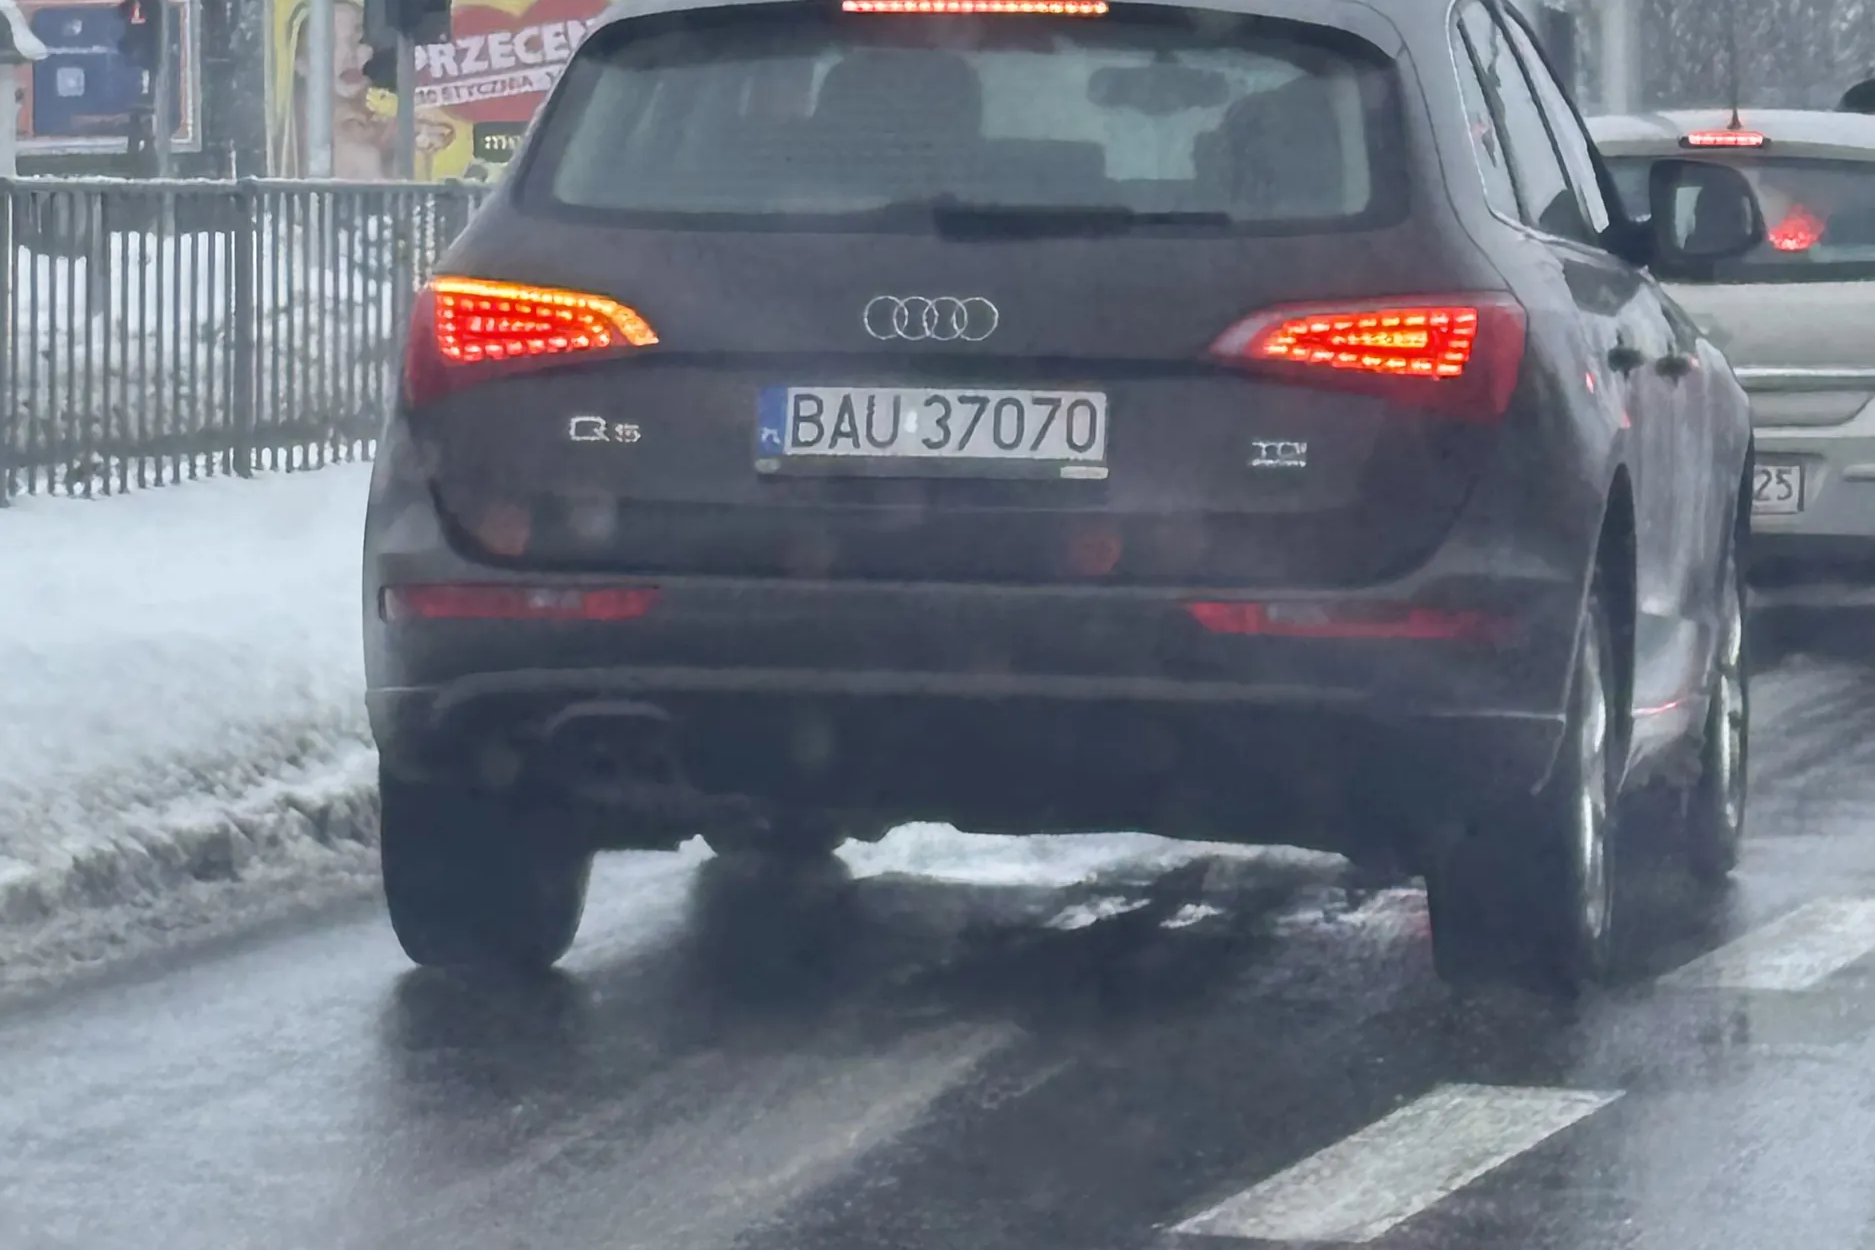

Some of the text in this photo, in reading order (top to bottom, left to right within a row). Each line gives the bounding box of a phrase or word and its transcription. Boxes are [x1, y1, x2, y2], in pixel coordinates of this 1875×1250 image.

[569, 415, 642, 443] Q5
[791, 393, 1098, 453] BAU 37070
